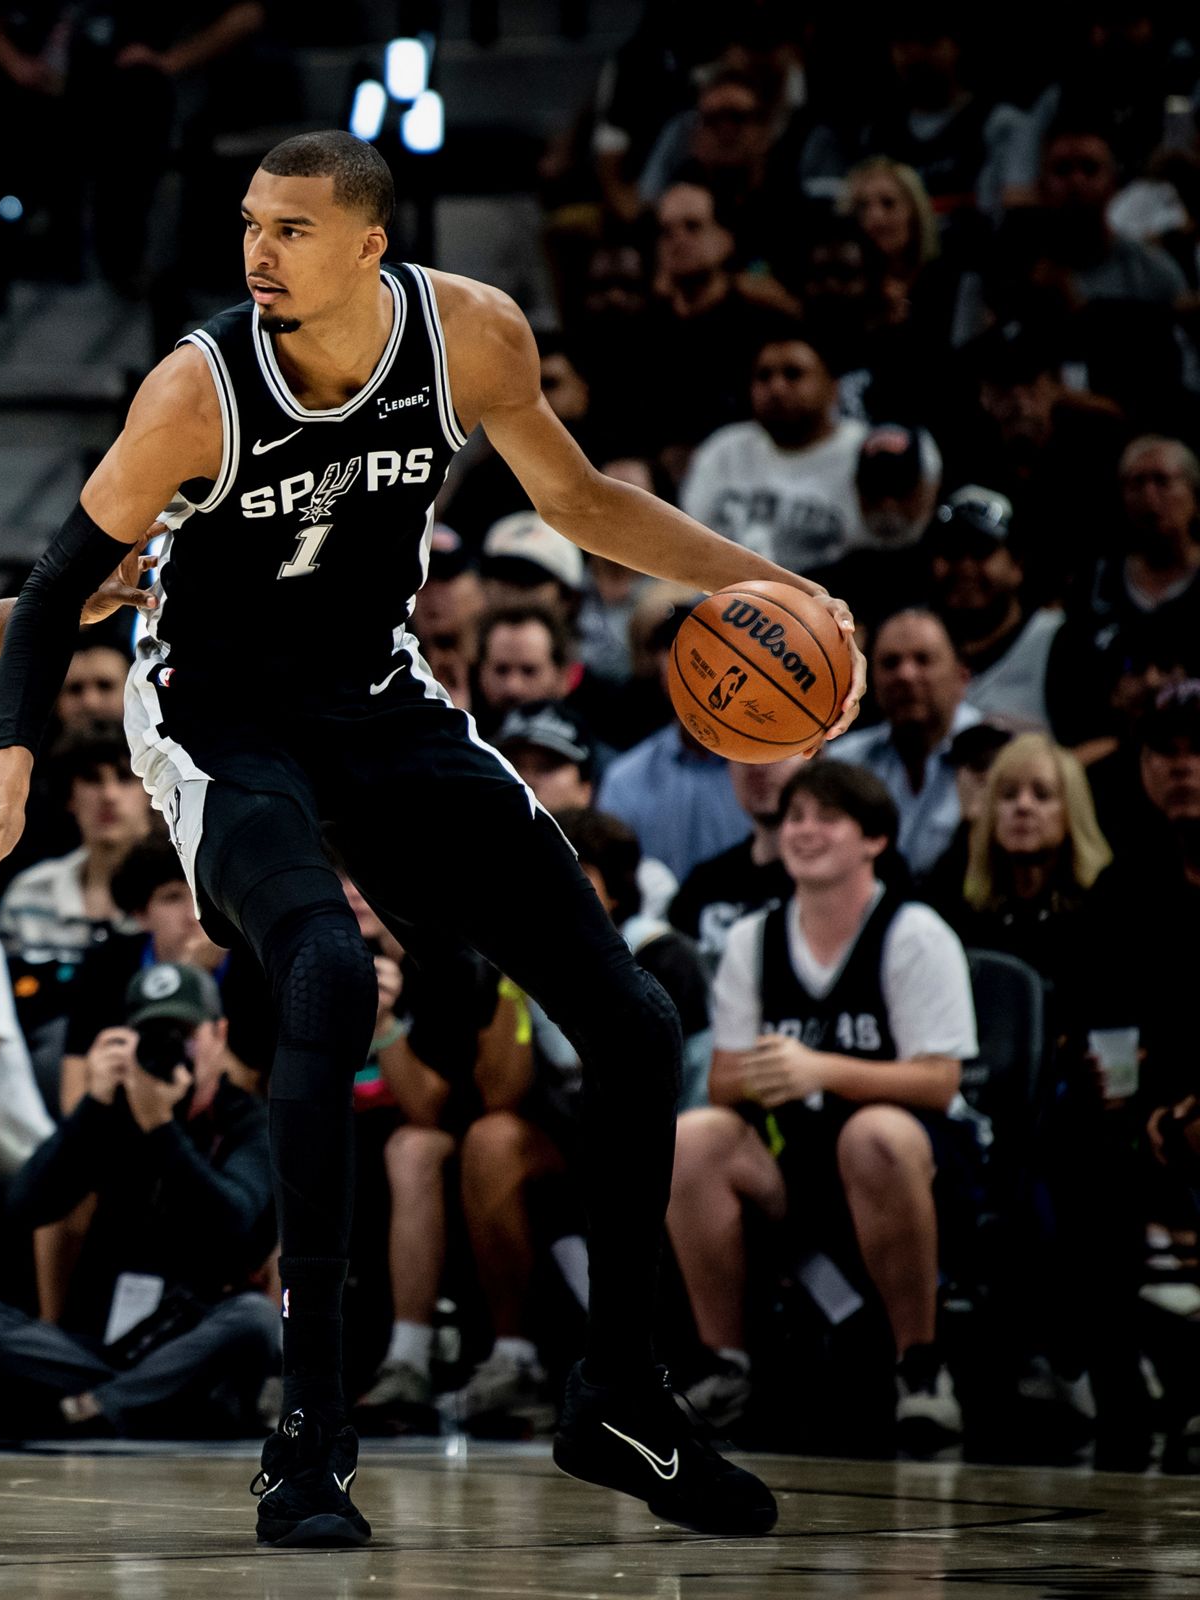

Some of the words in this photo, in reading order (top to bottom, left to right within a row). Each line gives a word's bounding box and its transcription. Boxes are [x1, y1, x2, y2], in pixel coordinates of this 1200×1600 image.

[385, 394, 424, 412] LEDGER
[241, 448, 434, 523] SPURS
[277, 524, 333, 580] 1
[721, 598, 817, 694] Wilson
